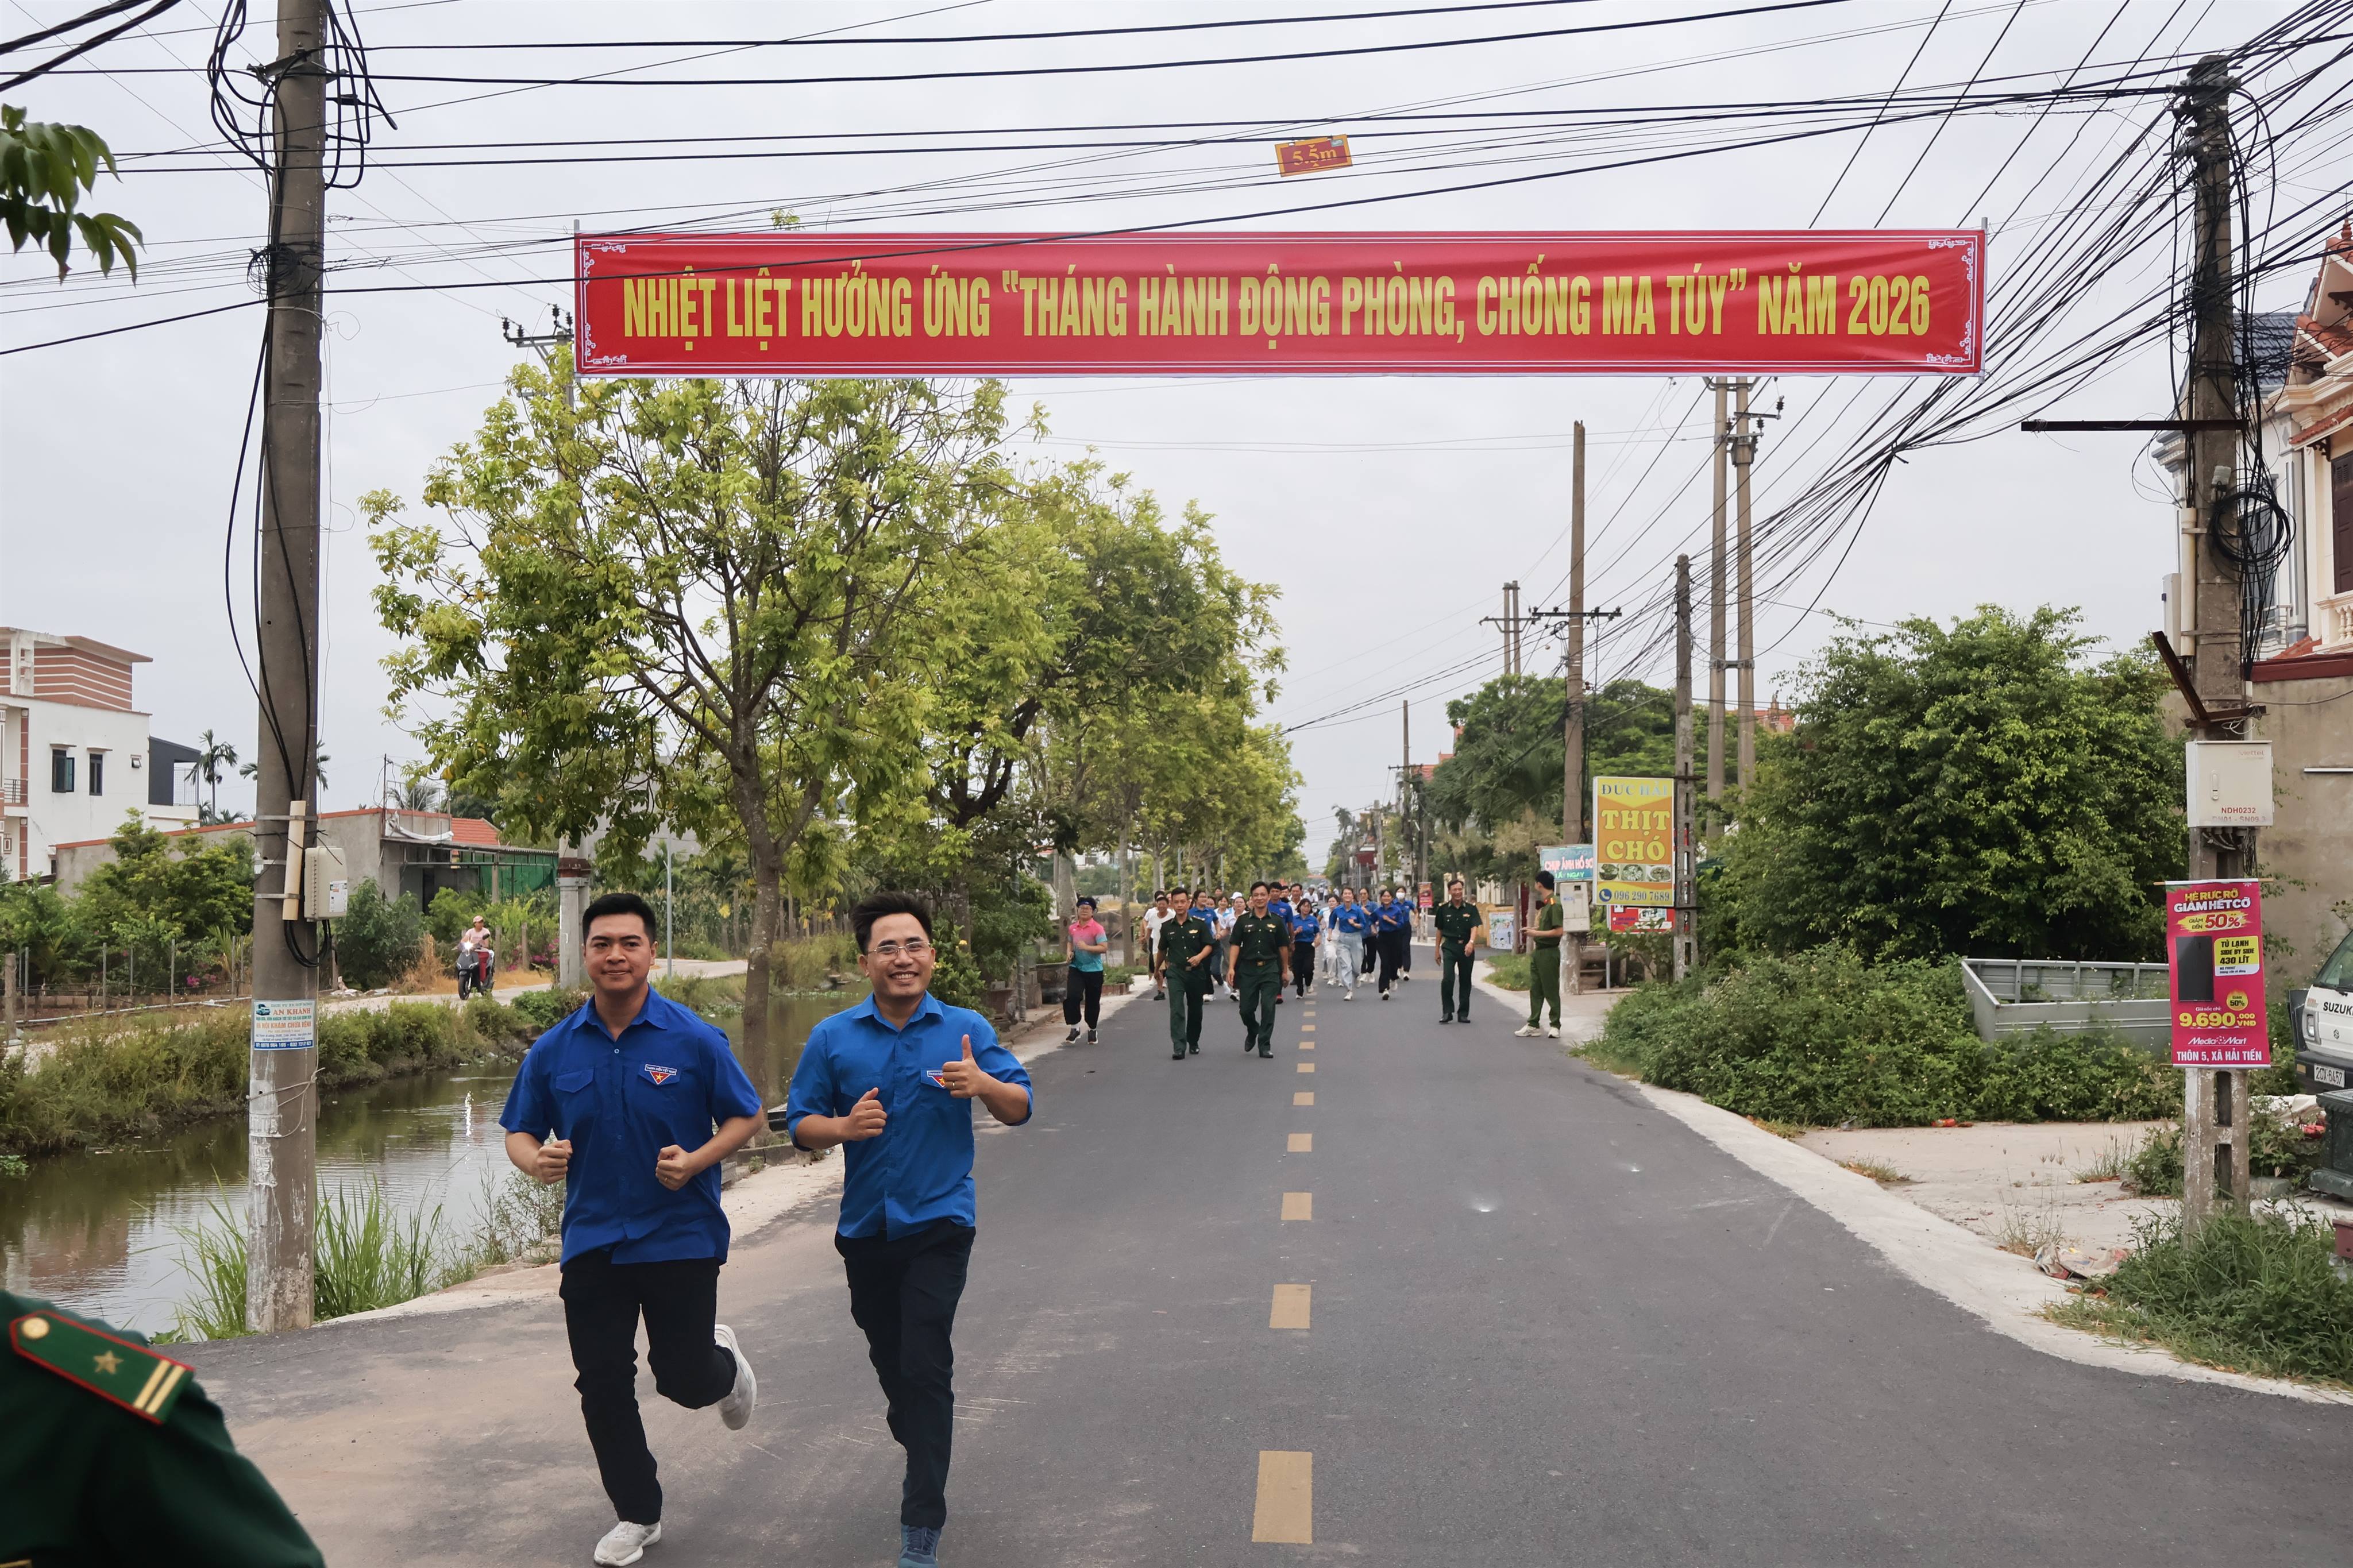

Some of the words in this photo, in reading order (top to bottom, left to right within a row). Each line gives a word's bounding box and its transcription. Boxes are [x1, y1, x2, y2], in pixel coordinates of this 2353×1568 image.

[1293, 148, 1337, 165] 5.5m
[624, 265, 716, 351] NHIỆT
[726, 267, 792, 351] LIỆT
[801, 259, 912, 338] HƯỞNG
[923, 264, 990, 337] ỨNG
[1139, 264, 1229, 336] HÀNH
[1239, 263, 1330, 349] ĐỘNG
[1341, 261, 1465, 343] PHÒNG,
[1476, 254, 1591, 336] CHỐNG
[1602, 276, 1656, 335] MA
[1758, 262, 1837, 335] NĂM
[1847, 275, 1930, 336] 2026
[1602, 810, 1671, 836] THỊT
[1606, 835, 1665, 861] CHÓ
[1614, 891, 1629, 900] 096
[1632, 891, 1647, 901] 290
[1649, 891, 1670, 901] 7689
[2185, 891, 2199, 901] HÈ
[2223, 888, 2239, 898] RỠ
[2174, 901, 2207, 912] GIẢM
[2209, 899, 2232, 910] HẾT
[2232, 897, 2251, 908] CỠ
[2205, 914, 2240, 928] 50%
[2221, 939, 2229, 948] TỦ
[2232, 940, 2249, 948] LẠNH
[2239, 955, 2250, 963] LÍT
[2323, 1002, 2353, 1016] SUZUK
[2179, 1012, 2236, 1027] 9.690
[2177, 1049, 2199, 1061] THÔN
[2201, 1051, 2209, 1062] 5,
[2211, 1049, 2223, 1061] XÃ
[2225, 1048, 2240, 1061] HẢI
[2242, 1048, 2262, 1061] TIẾN
